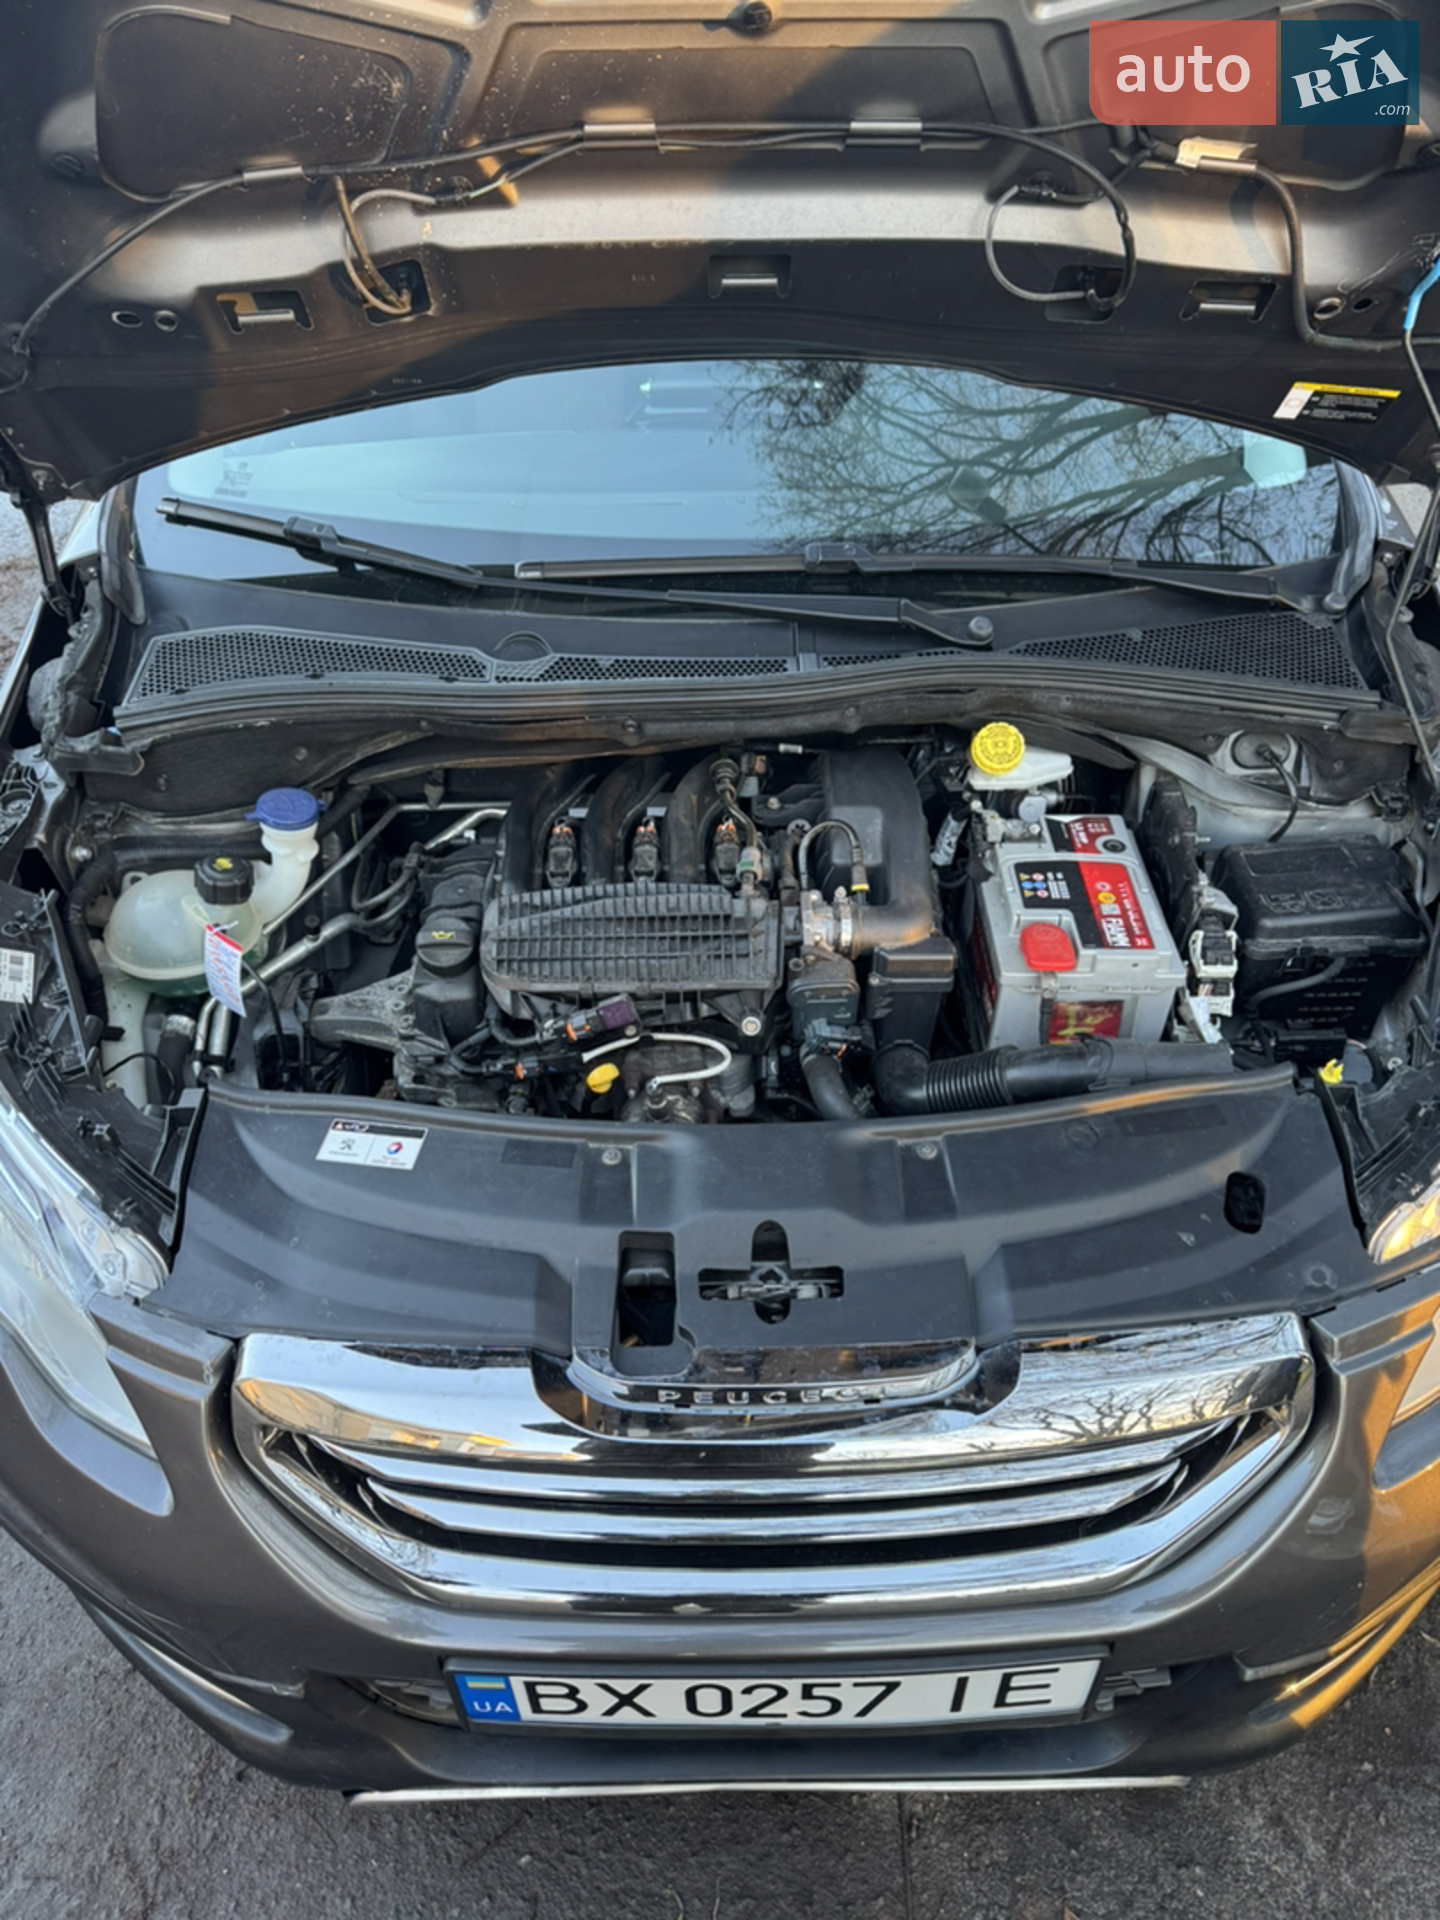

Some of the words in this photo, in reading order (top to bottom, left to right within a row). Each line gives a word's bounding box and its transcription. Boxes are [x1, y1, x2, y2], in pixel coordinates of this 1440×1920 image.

[472, 1701, 513, 1714] UA
[522, 1681, 657, 1718] BX
[684, 1681, 902, 1718] 0257
[949, 1667, 1061, 1713] IE
